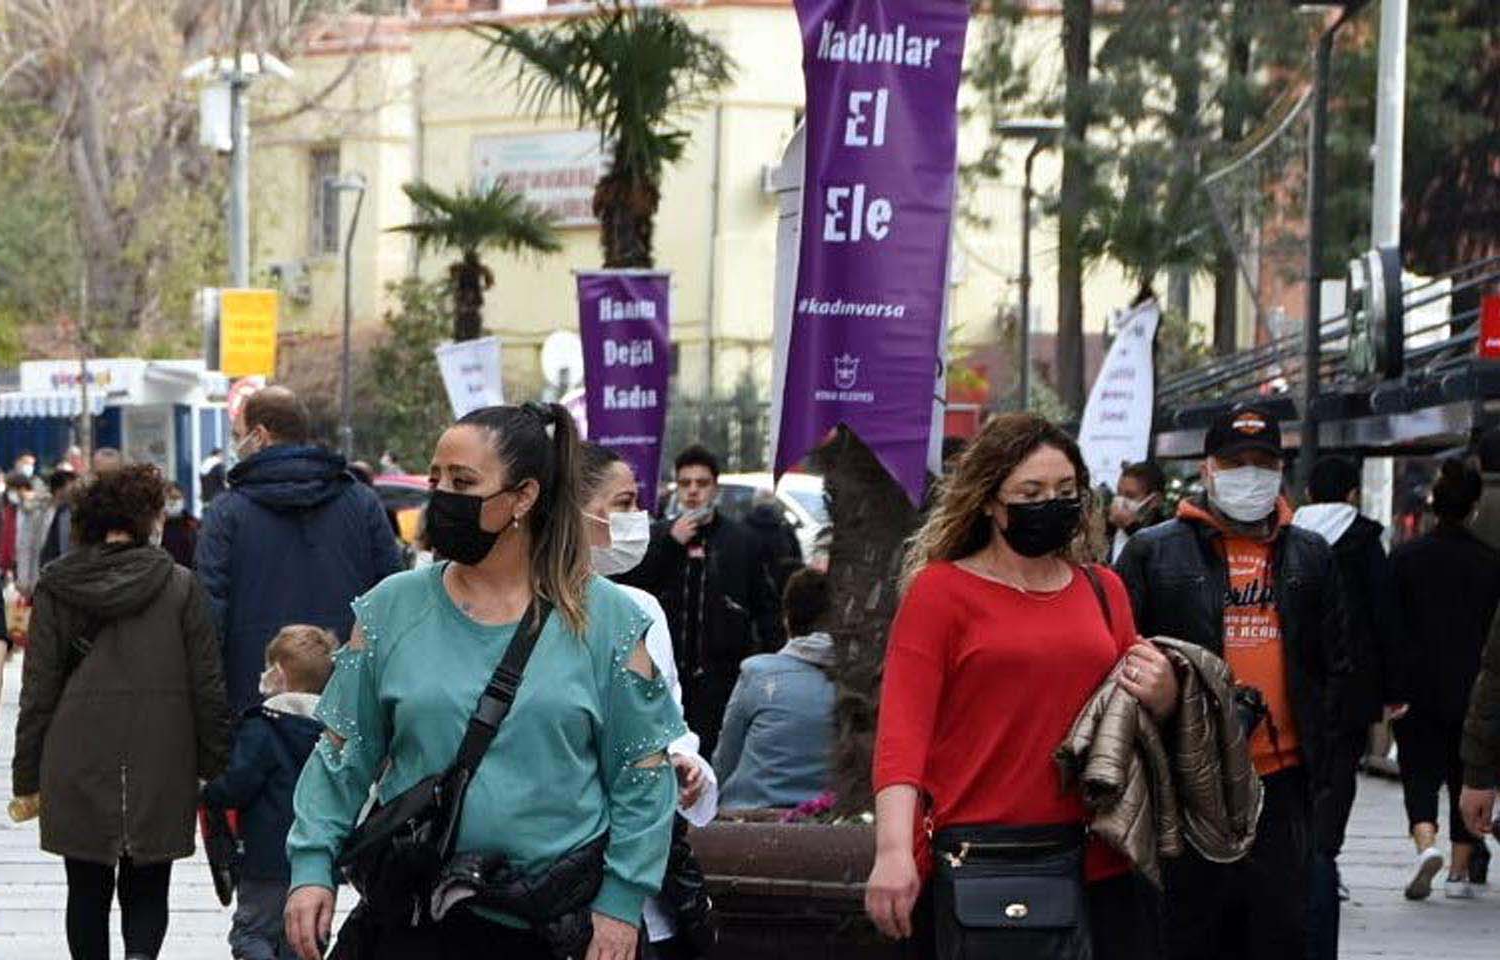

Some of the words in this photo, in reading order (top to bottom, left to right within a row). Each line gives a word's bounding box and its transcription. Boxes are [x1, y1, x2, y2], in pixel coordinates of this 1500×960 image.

[845, 88, 888, 146] El
[823, 183, 893, 242] Ele
[599, 297, 656, 322] Hanım
[602, 338, 654, 367] Değil
[603, 384, 657, 409] Kadın
